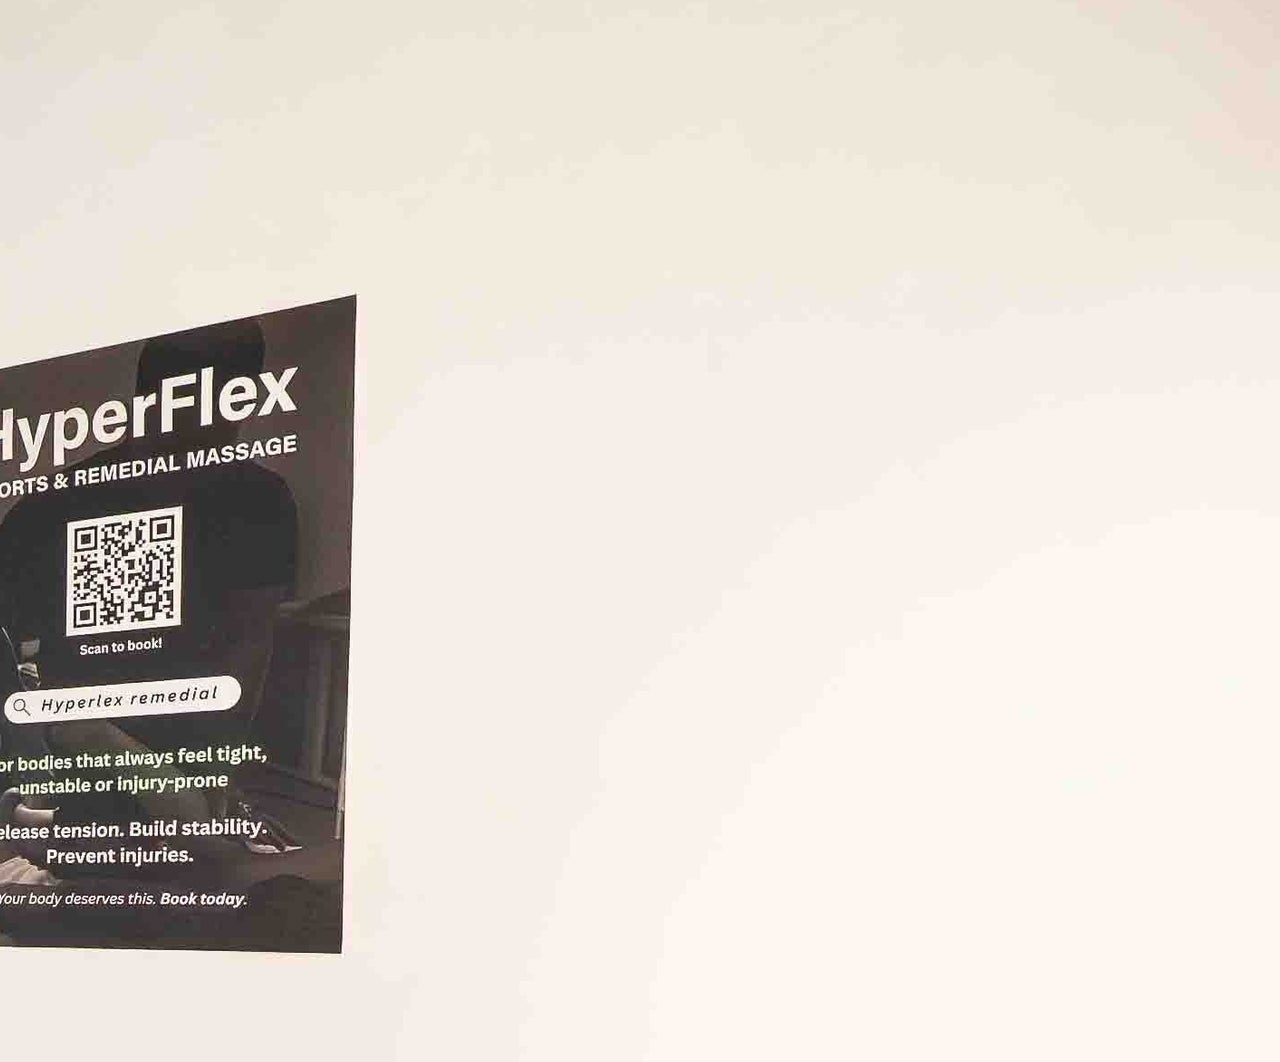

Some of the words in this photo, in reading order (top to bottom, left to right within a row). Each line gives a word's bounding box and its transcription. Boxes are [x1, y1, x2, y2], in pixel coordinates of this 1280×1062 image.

[54, 474, 68, 489] &
[75, 455, 180, 486] REMEDIAL
[187, 434, 297, 468] MASSAGE
[79, 642, 109, 656] Scan
[112, 641, 125, 654] to
[127, 637, 162, 652] book!
[41, 692, 123, 714] Hyperlex
[131, 686, 218, 706] remedial
[17, 754, 72, 772] bodies
[76, 752, 111, 768] that
[114, 749, 173, 768] always
[178, 747, 212, 762] feel
[216, 745, 268, 763] tight,
[18, 777, 91, 795] unstable
[95, 777, 113, 792] or
[117, 772, 228, 794] injury-prone
[53, 822, 125, 839] tension.
[129, 821, 178, 837] Build
[181, 818, 268, 839] stability.
[46, 848, 115, 864] Prevent
[120, 846, 194, 866] injuries.
[29, 892, 61, 908] body
[65, 892, 125, 906] deserves
[127, 892, 156, 906] this.
[160, 892, 197, 906] Book
[200, 893, 247, 908] today.
